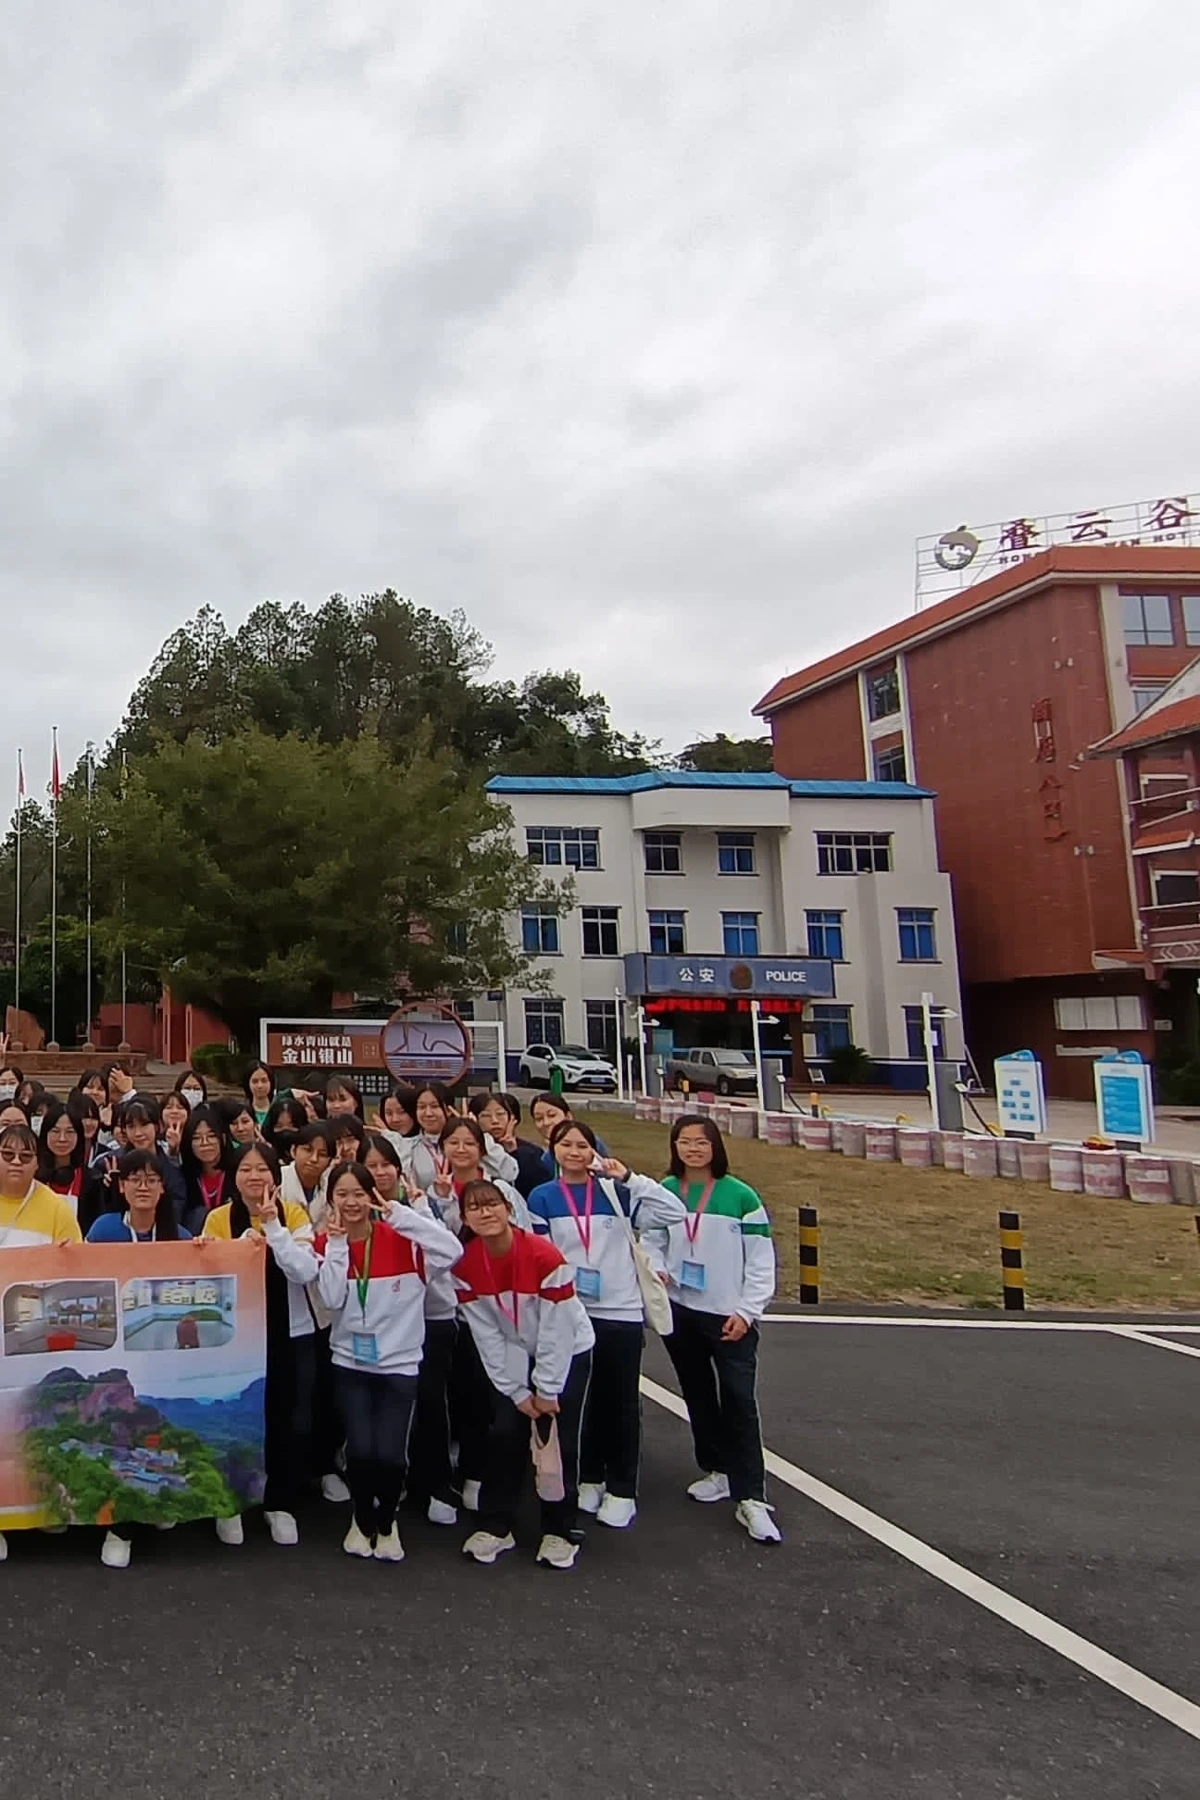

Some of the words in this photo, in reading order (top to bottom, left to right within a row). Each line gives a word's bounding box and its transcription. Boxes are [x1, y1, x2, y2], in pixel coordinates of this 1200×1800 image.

[679, 967, 715, 983] 公安
[766, 970, 807, 983] POLICE
[281, 1048, 353, 1065] 金山银山
